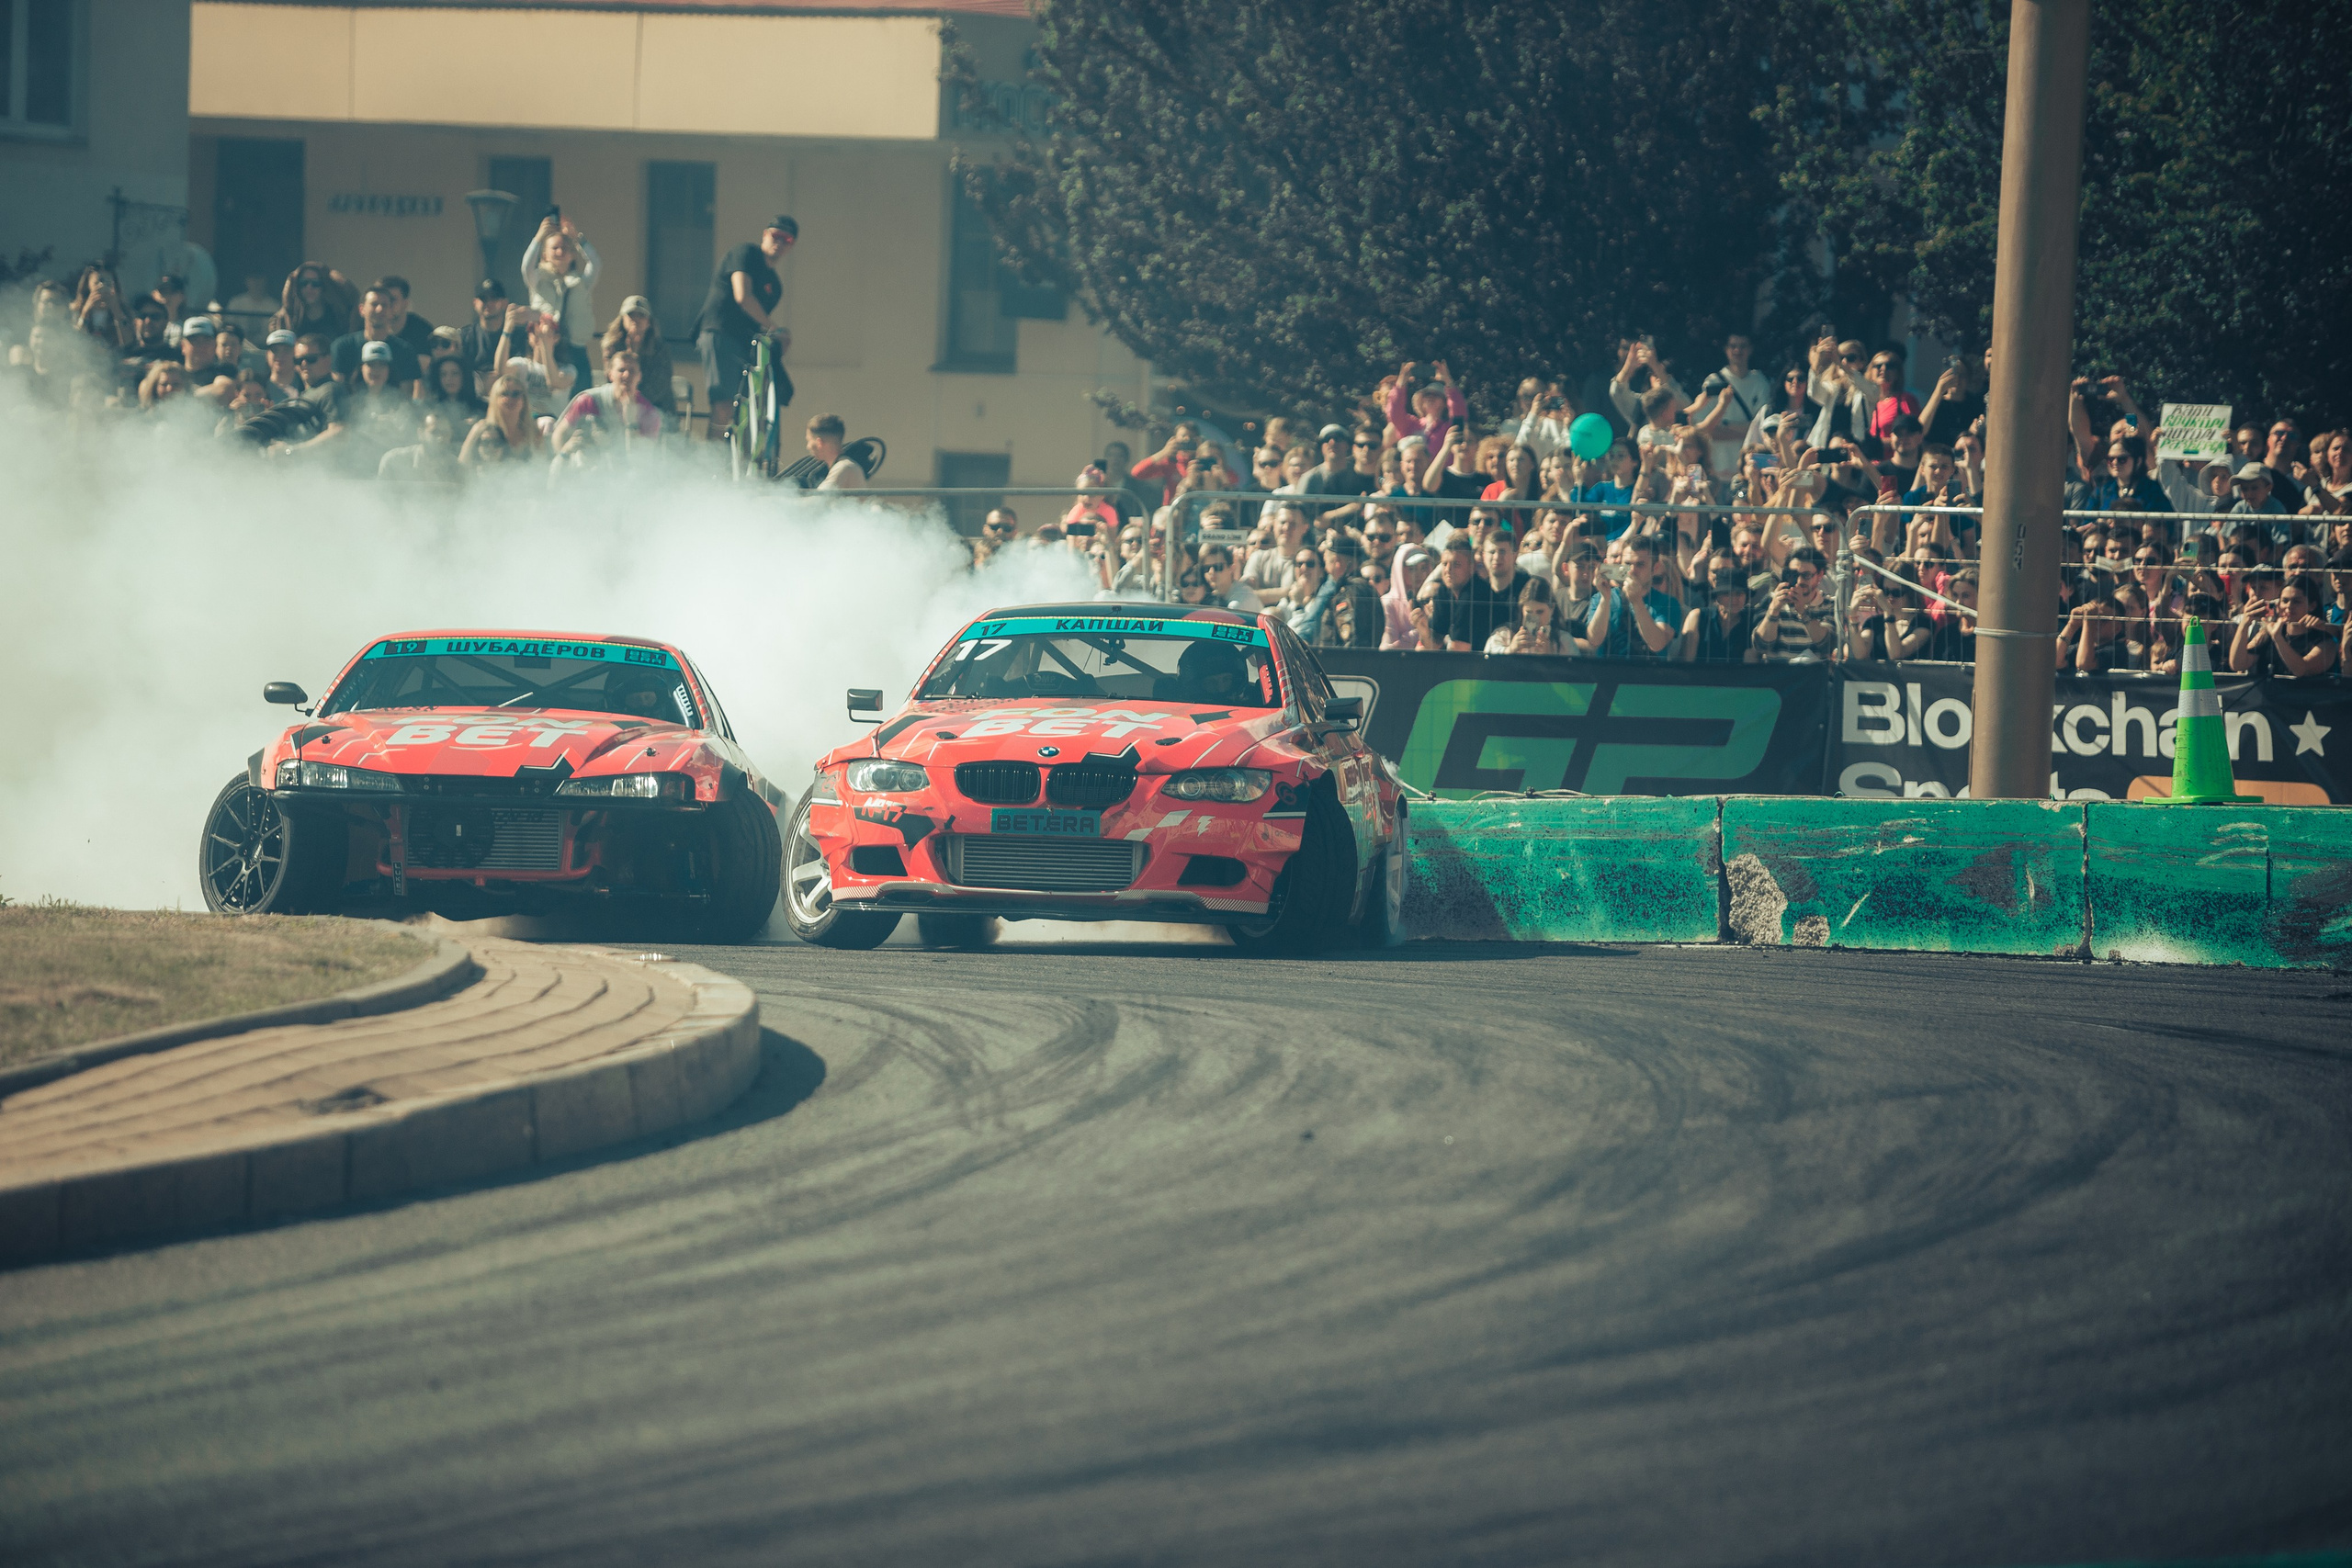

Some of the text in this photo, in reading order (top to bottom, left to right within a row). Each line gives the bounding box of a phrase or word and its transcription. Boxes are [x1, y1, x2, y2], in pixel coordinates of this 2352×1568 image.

[980, 623, 1007, 636] 17
[394, 641, 605, 659] 19 ШУБАДЁРОВ
[956, 638, 1012, 661] 17
[391, 715, 594, 729] FON
[970, 707, 1173, 723] FON
[385, 724, 589, 748] BET
[959, 718, 1164, 739] BET
